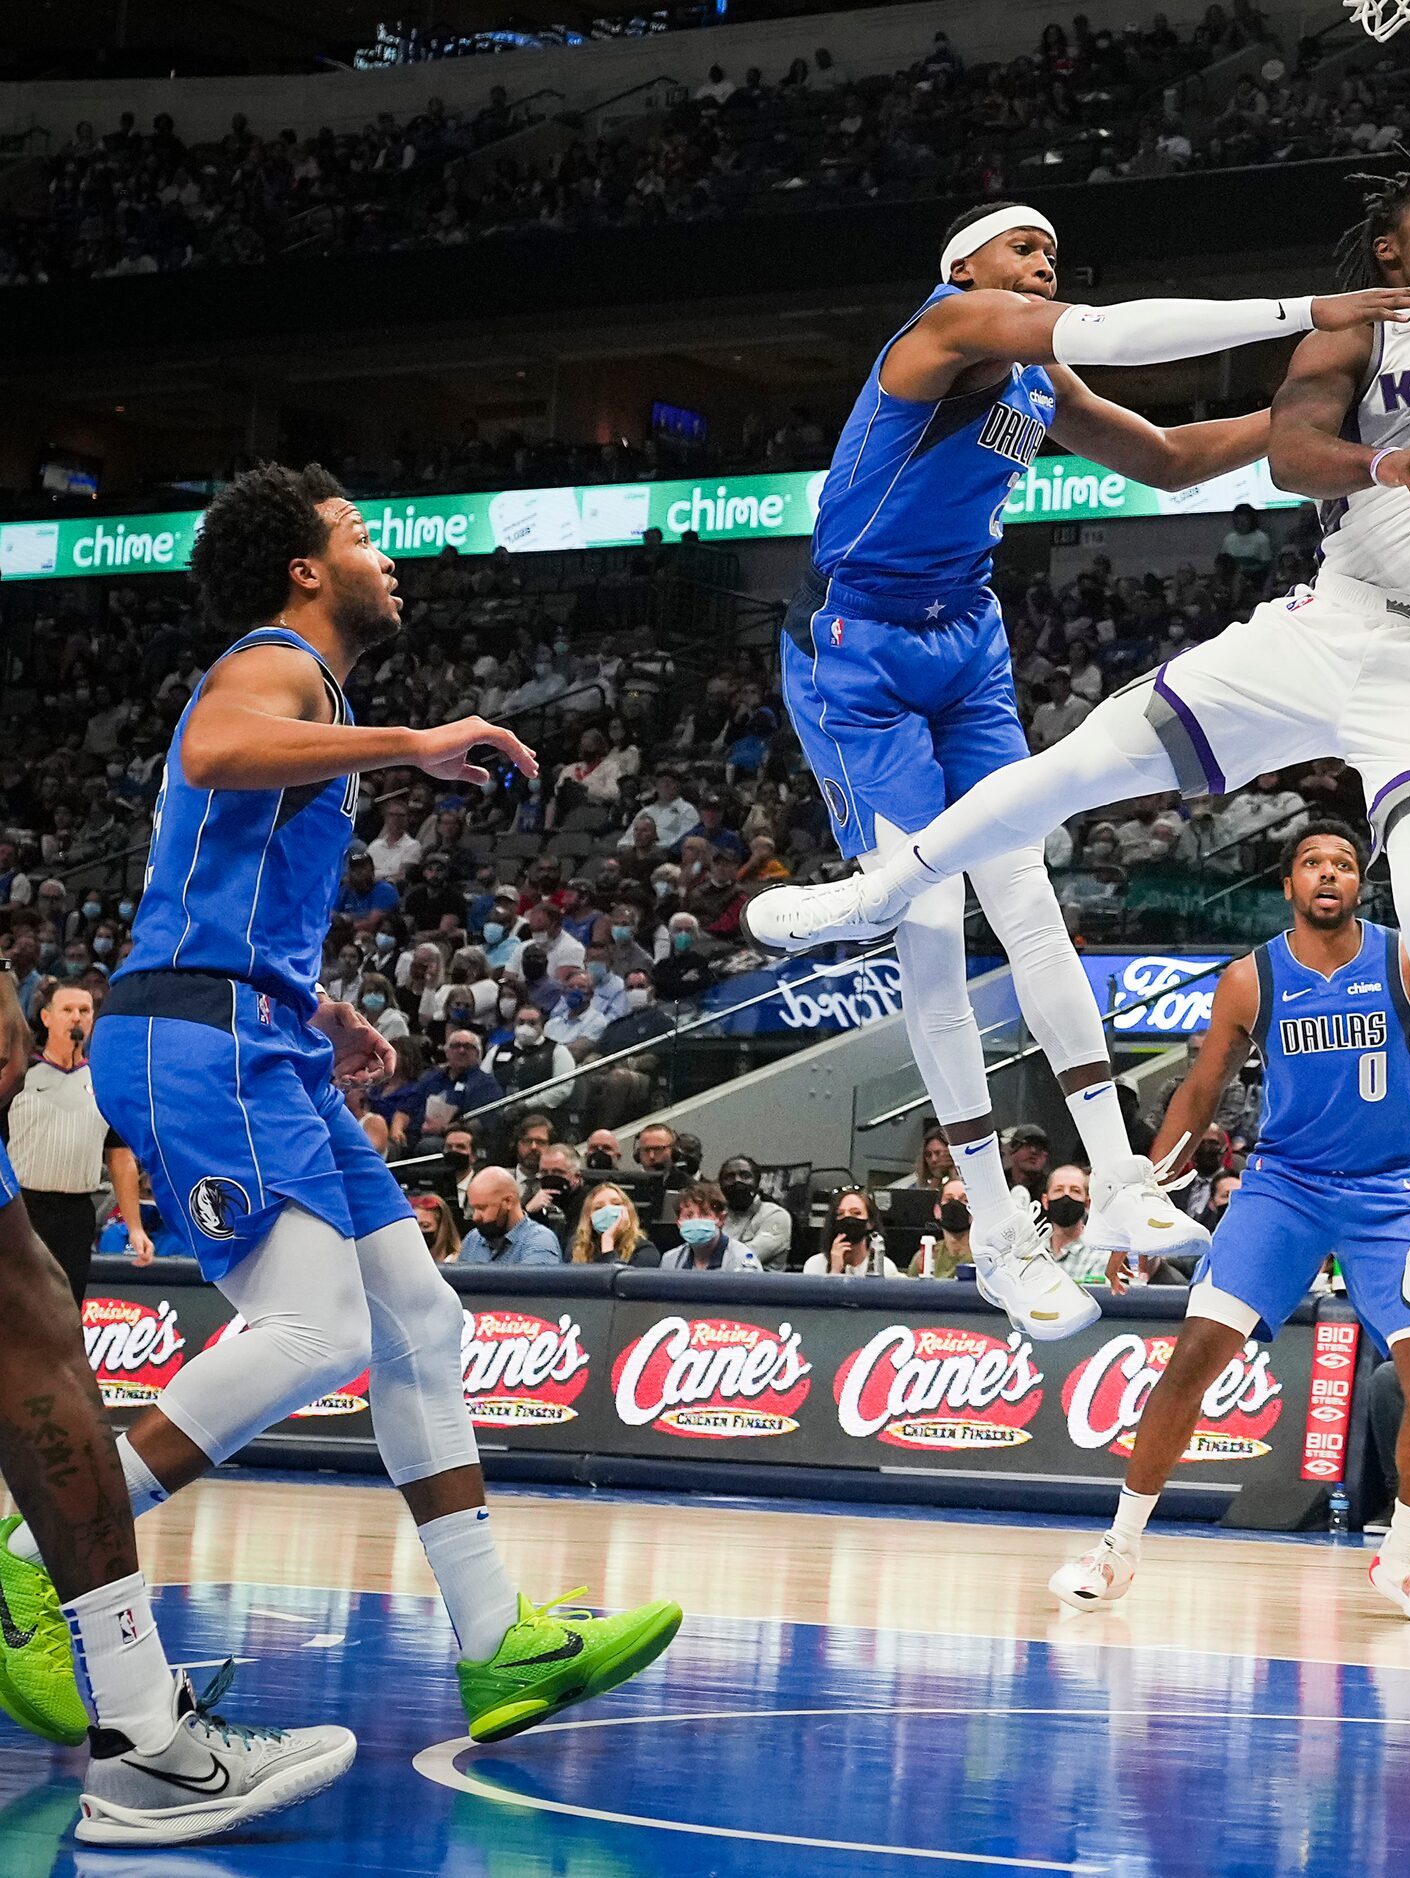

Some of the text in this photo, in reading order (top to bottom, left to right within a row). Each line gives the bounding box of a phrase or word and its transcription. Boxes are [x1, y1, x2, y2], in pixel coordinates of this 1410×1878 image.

[1029, 389, 1054, 409] chime
[977, 401, 1047, 469] DALLA
[666, 485, 784, 533] chime
[72, 524, 174, 568] chime
[1113, 955, 1221, 1030] For
[1346, 982, 1383, 996] chime
[1279, 1011, 1388, 1056] DALLAS
[1359, 1051, 1388, 1102] 0
[84, 1301, 141, 1326] Raising
[476, 1314, 541, 1340] Raising
[690, 1322, 761, 1349] Raising
[1317, 1326, 1355, 1344] BIO
[915, 1331, 988, 1357] Raising
[1316, 1343, 1353, 1353] STEEL
[615, 1315, 814, 1426] Cane's
[837, 1324, 1045, 1438] Cane's
[1066, 1333, 1284, 1450] Cae's
[1310, 1396, 1348, 1406] STEEL
[1311, 1379, 1350, 1397] BIO
[1305, 1432, 1344, 1450] BIO
[1304, 1450, 1342, 1459] STEEL
